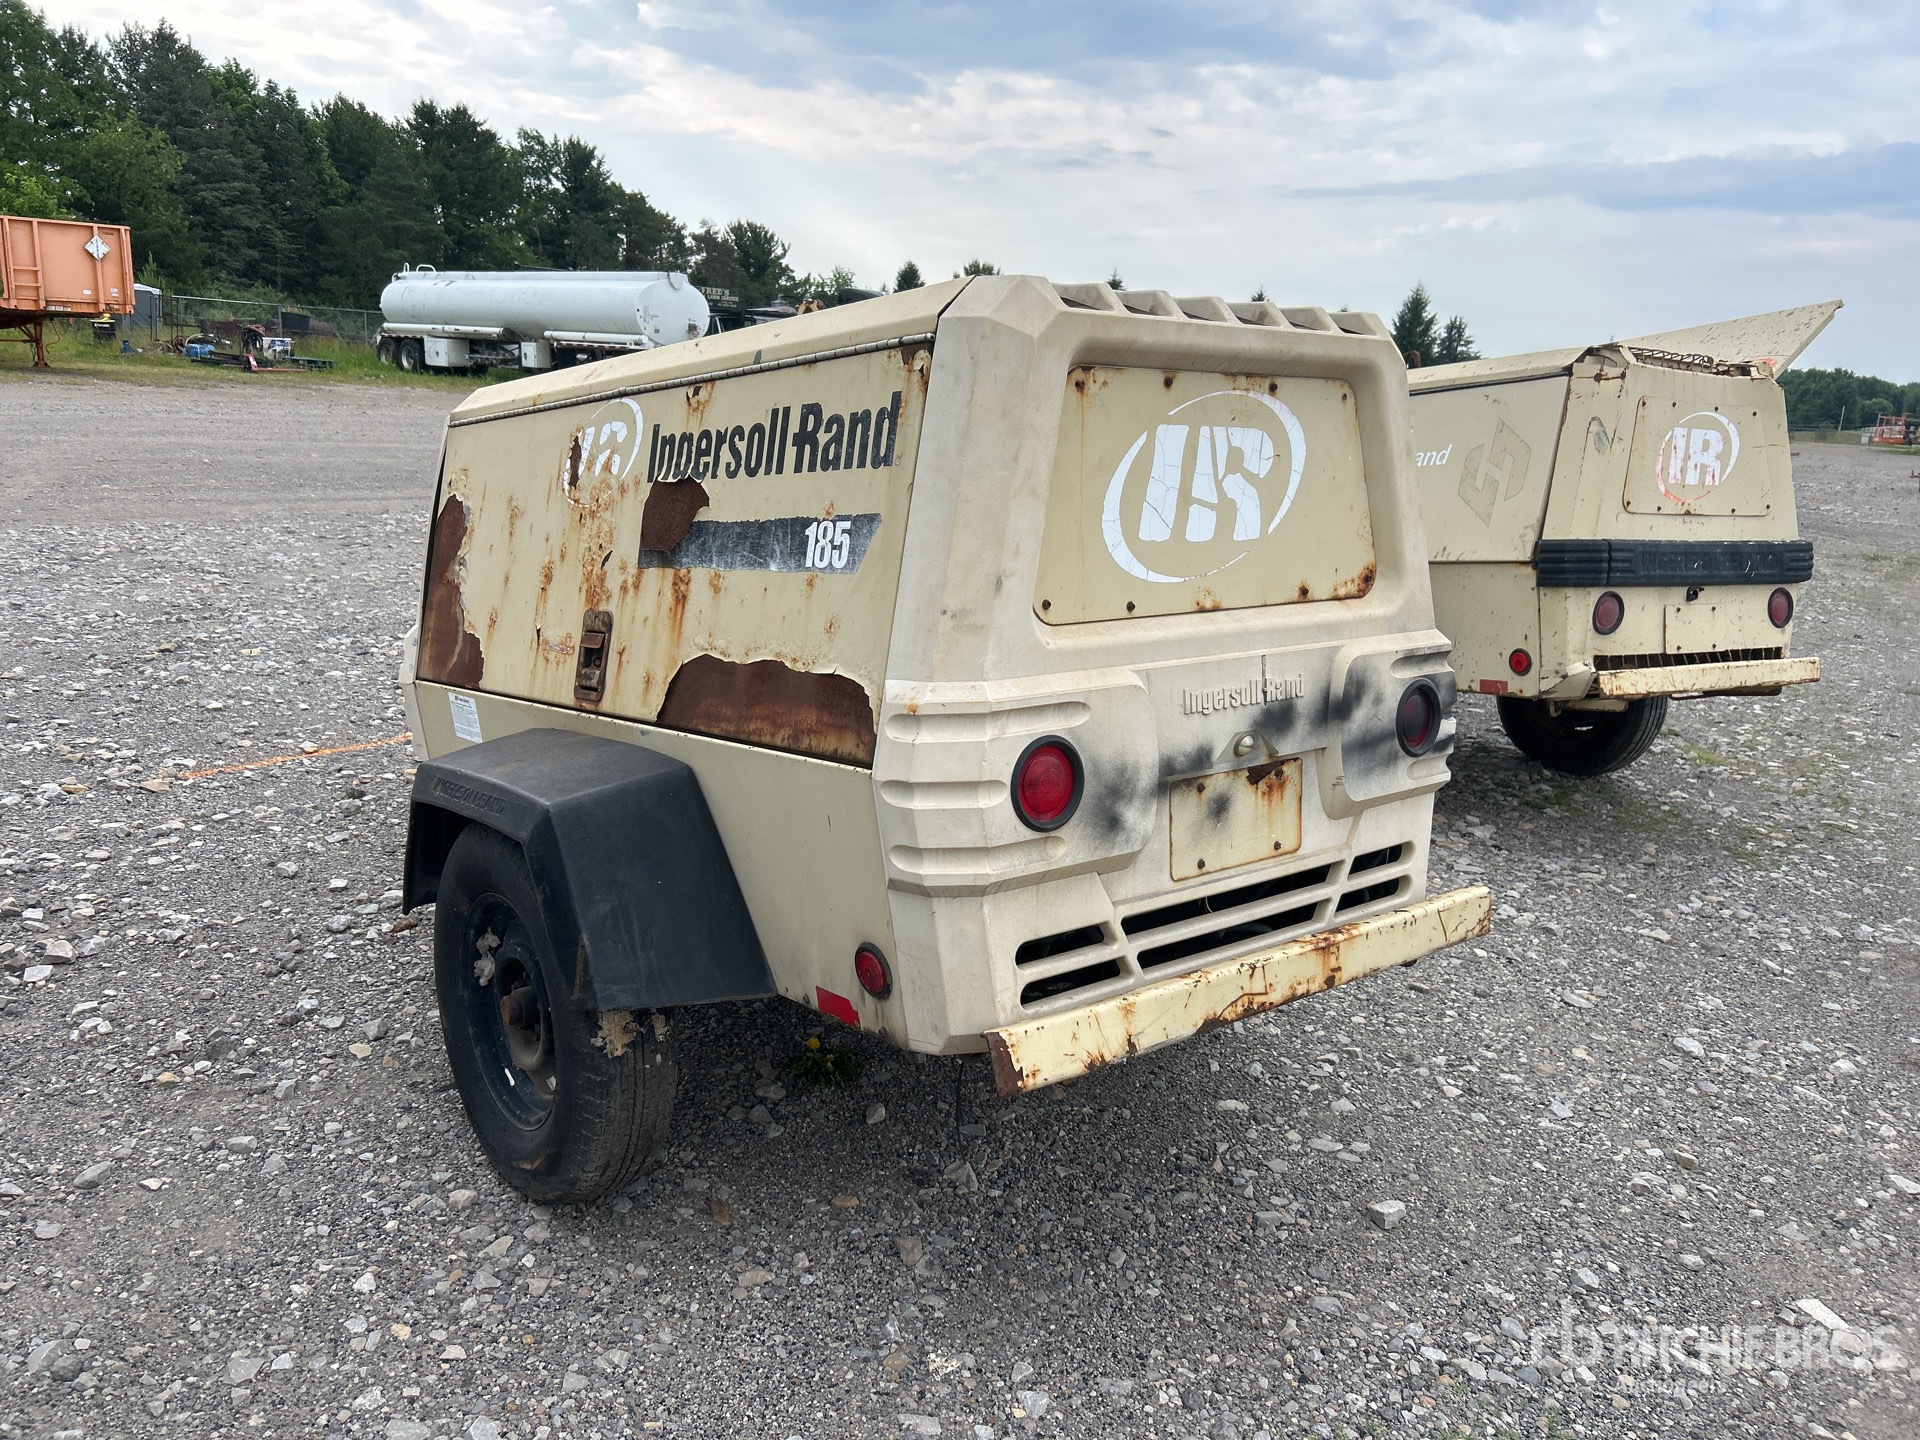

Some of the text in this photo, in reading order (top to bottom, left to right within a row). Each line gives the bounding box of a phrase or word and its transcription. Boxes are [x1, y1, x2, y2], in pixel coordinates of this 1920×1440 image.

[701, 287, 730, 296] FRED'S
[1668, 427, 1724, 486] IR
[804, 520, 852, 569] 185
